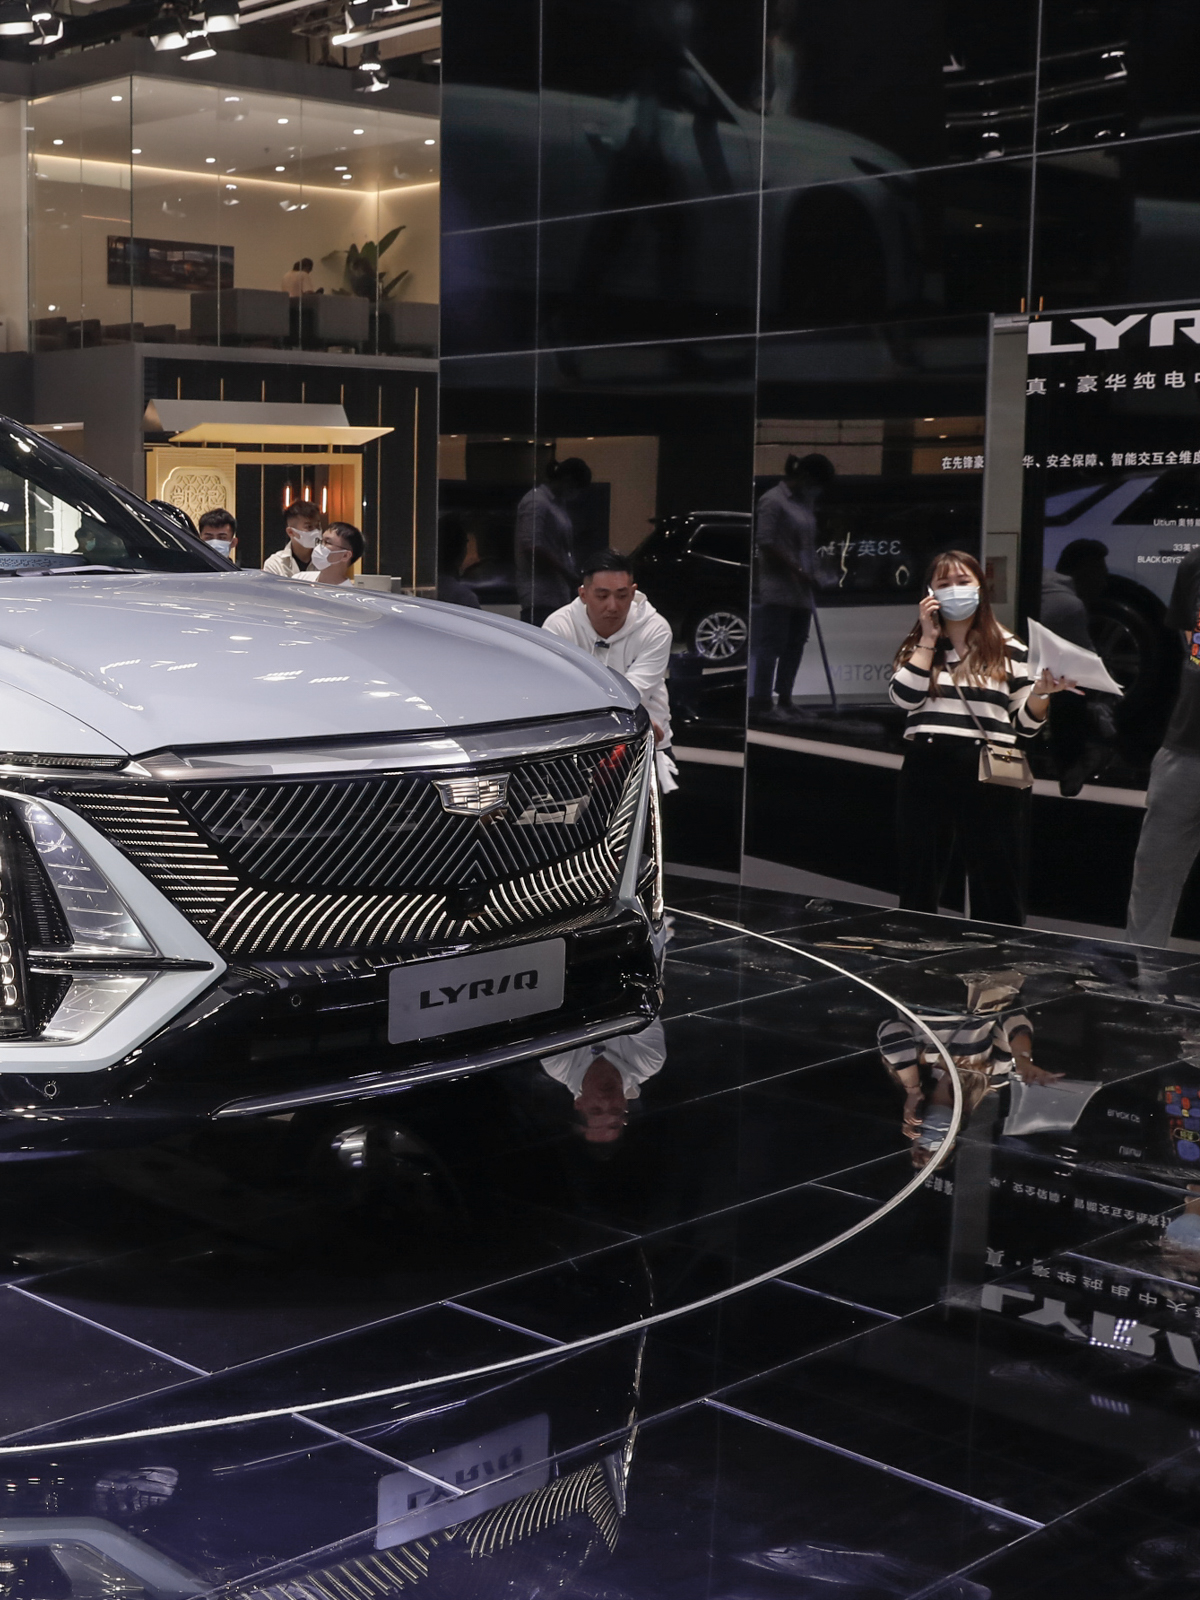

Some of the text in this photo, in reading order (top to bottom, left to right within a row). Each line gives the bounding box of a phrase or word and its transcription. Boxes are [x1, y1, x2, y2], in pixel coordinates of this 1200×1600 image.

[1028, 309, 1200, 354] LYR
[1026, 370, 1200, 395] 真·豪华纯电
[1137, 555, 1161, 564] BLACK
[420, 969, 538, 1010] LYRIQ
